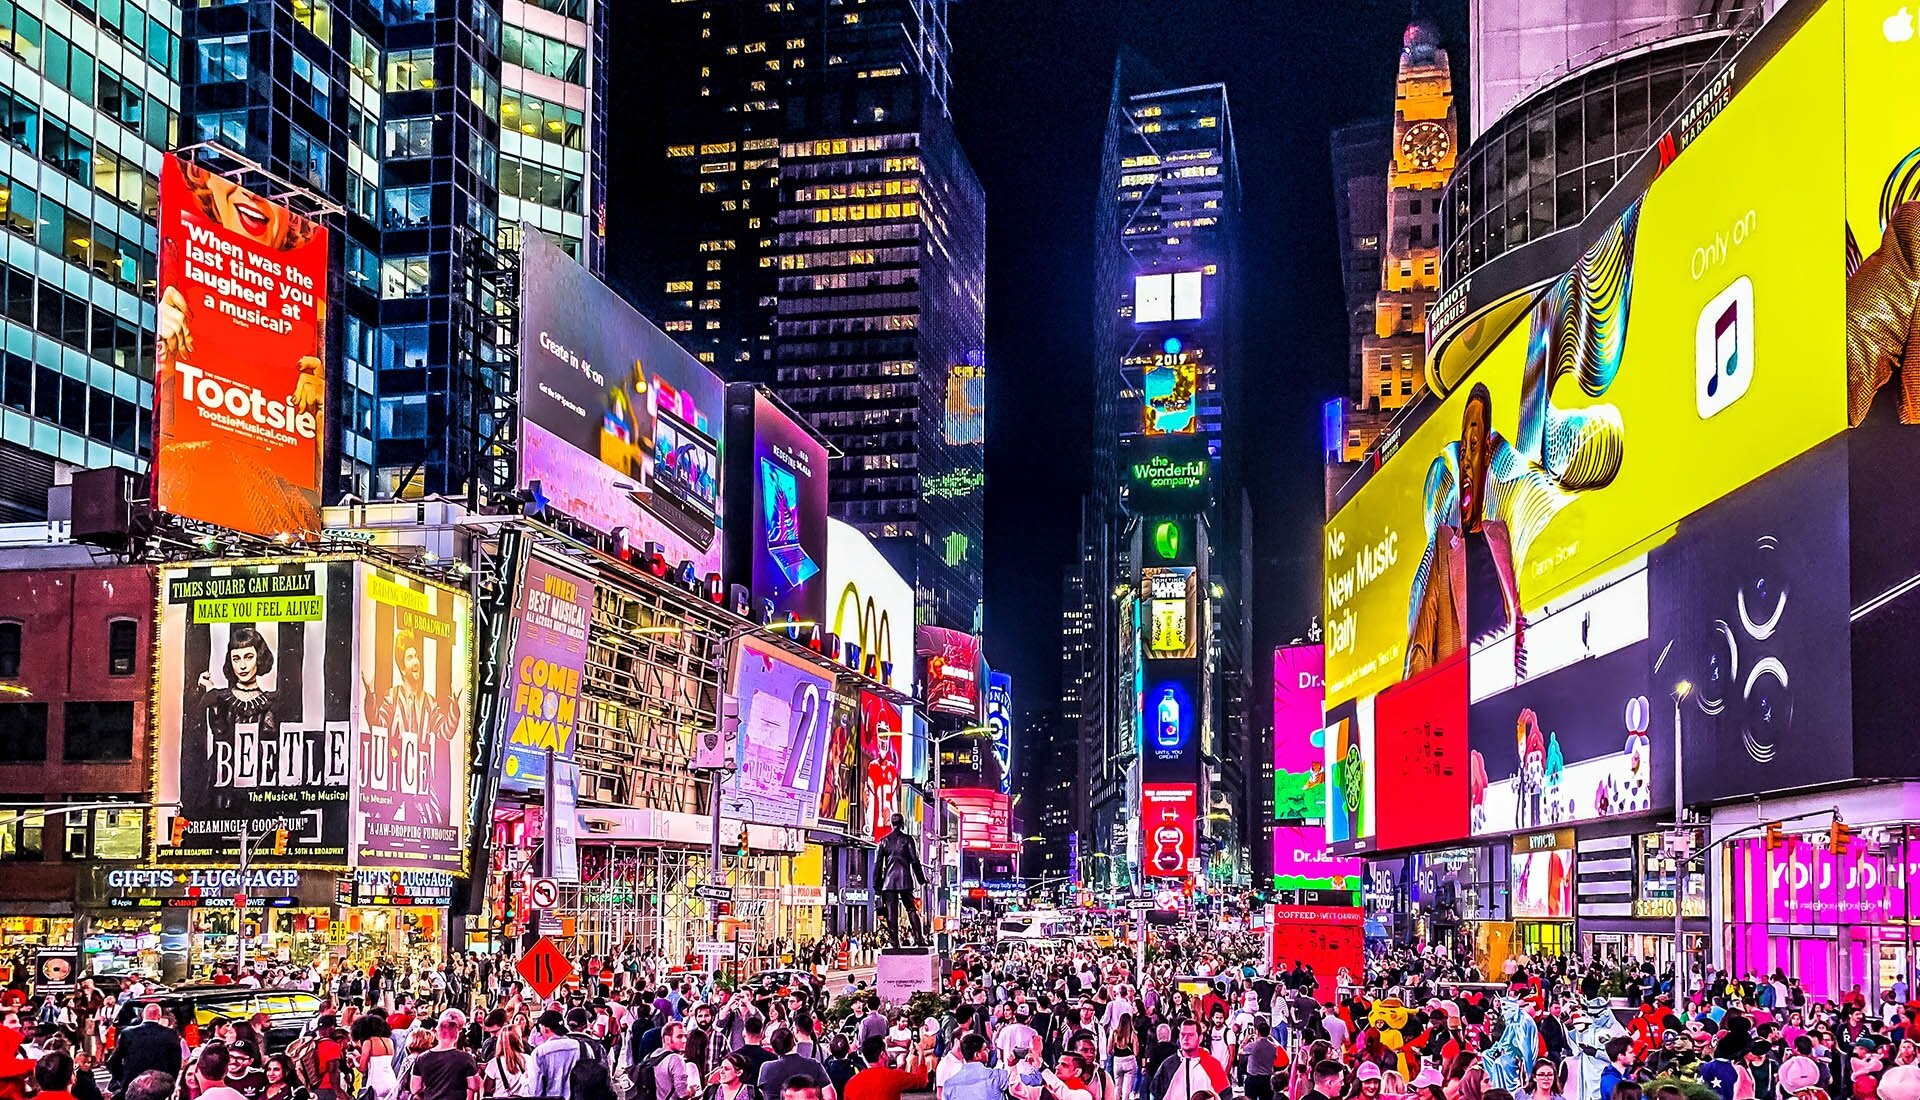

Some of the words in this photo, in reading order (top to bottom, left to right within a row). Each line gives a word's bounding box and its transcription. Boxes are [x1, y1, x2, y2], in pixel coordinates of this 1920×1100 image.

[1681, 62, 1737, 132] MARRIOTT
[1681, 92, 1729, 149] MARQUIS
[1691, 230, 1729, 280] Only
[1733, 210, 1756, 245] on
[186, 240, 223, 271] last
[230, 259, 274, 291] time
[280, 282, 313, 308] you
[248, 251, 282, 276] was
[285, 265, 313, 289] the
[185, 260, 268, 308] laughed
[281, 303, 301, 320] at
[1431, 278, 1472, 324] MARRIOTT
[204, 294, 215, 308] a
[220, 300, 292, 335] musical?
[1431, 300, 1465, 340] MARQUIS
[540, 331, 569, 363] Create
[570, 350, 579, 370] in
[592, 371, 604, 388] on
[1155, 354, 1187, 366] 2019
[175, 361, 316, 438] Tootsie
[197, 406, 297, 445] TootsieMusical.com
[1134, 462, 1204, 479] Wonderful
[1152, 456, 1169, 467] the
[172, 582, 203, 598] TIMES
[205, 578, 246, 597] SQUARE
[248, 576, 269, 594] CAN
[272, 574, 311, 592] REALLY
[1328, 566, 1355, 616] New
[1357, 526, 1398, 593] Music
[198, 603, 228, 618] MAKE
[232, 602, 252, 618] YOU
[256, 602, 282, 617] FEEL
[286, 600, 319, 616] ALIVE!
[403, 611, 413, 627] ON
[414, 614, 450, 637] BROADWAY!
[528, 588, 551, 616] BEST
[551, 597, 585, 629] MUSICAL
[1328, 610, 1357, 659] Daily
[520, 655, 579, 697] COME
[514, 683, 576, 725] FROM
[510, 715, 573, 753] AWAY
[214, 726, 348, 788] BEETLE
[972, 739, 980, 771] 1500
[248, 791, 263, 802] The
[300, 791, 316, 801] The
[108, 870, 173, 887] GIFTS
[190, 869, 299, 888] LUGGAGE
[355, 870, 391, 886] GIFTS
[400, 871, 453, 888] LUGGAGE
[715, 890, 728, 898] WAY
[168, 898, 198, 907] Canon
[205, 898, 235, 907] SONY
[1277, 911, 1316, 919] COFFEED
[330, 922, 338, 942] ATM
